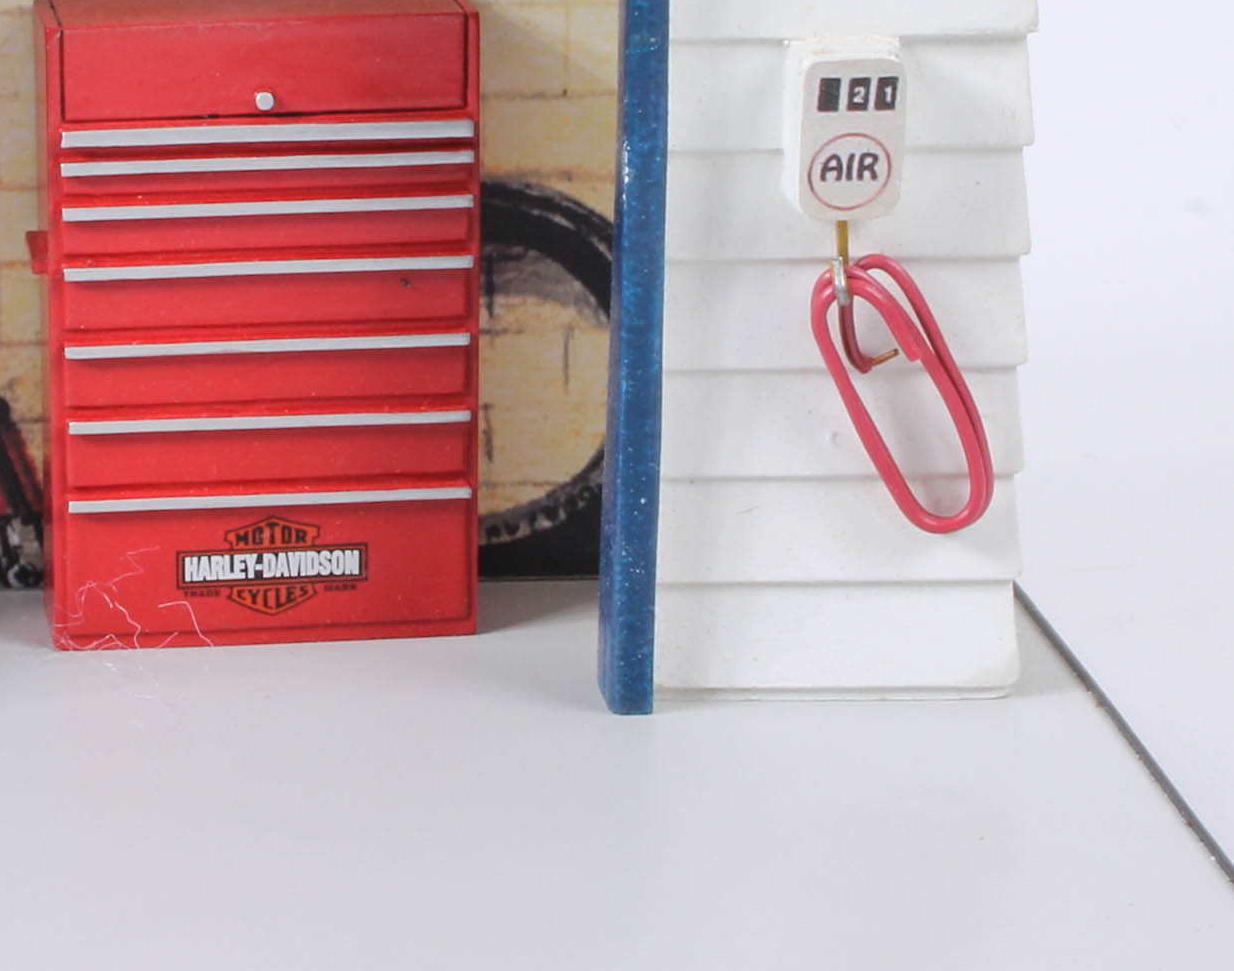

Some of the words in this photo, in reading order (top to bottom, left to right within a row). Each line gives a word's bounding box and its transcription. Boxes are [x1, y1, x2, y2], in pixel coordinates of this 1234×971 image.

[819, 152, 879, 182] AIR
[235, 522, 308, 546] MOTOR
[184, 549, 360, 582] HARLEY-DAVIDSON
[237, 584, 309, 610] CYCLES
